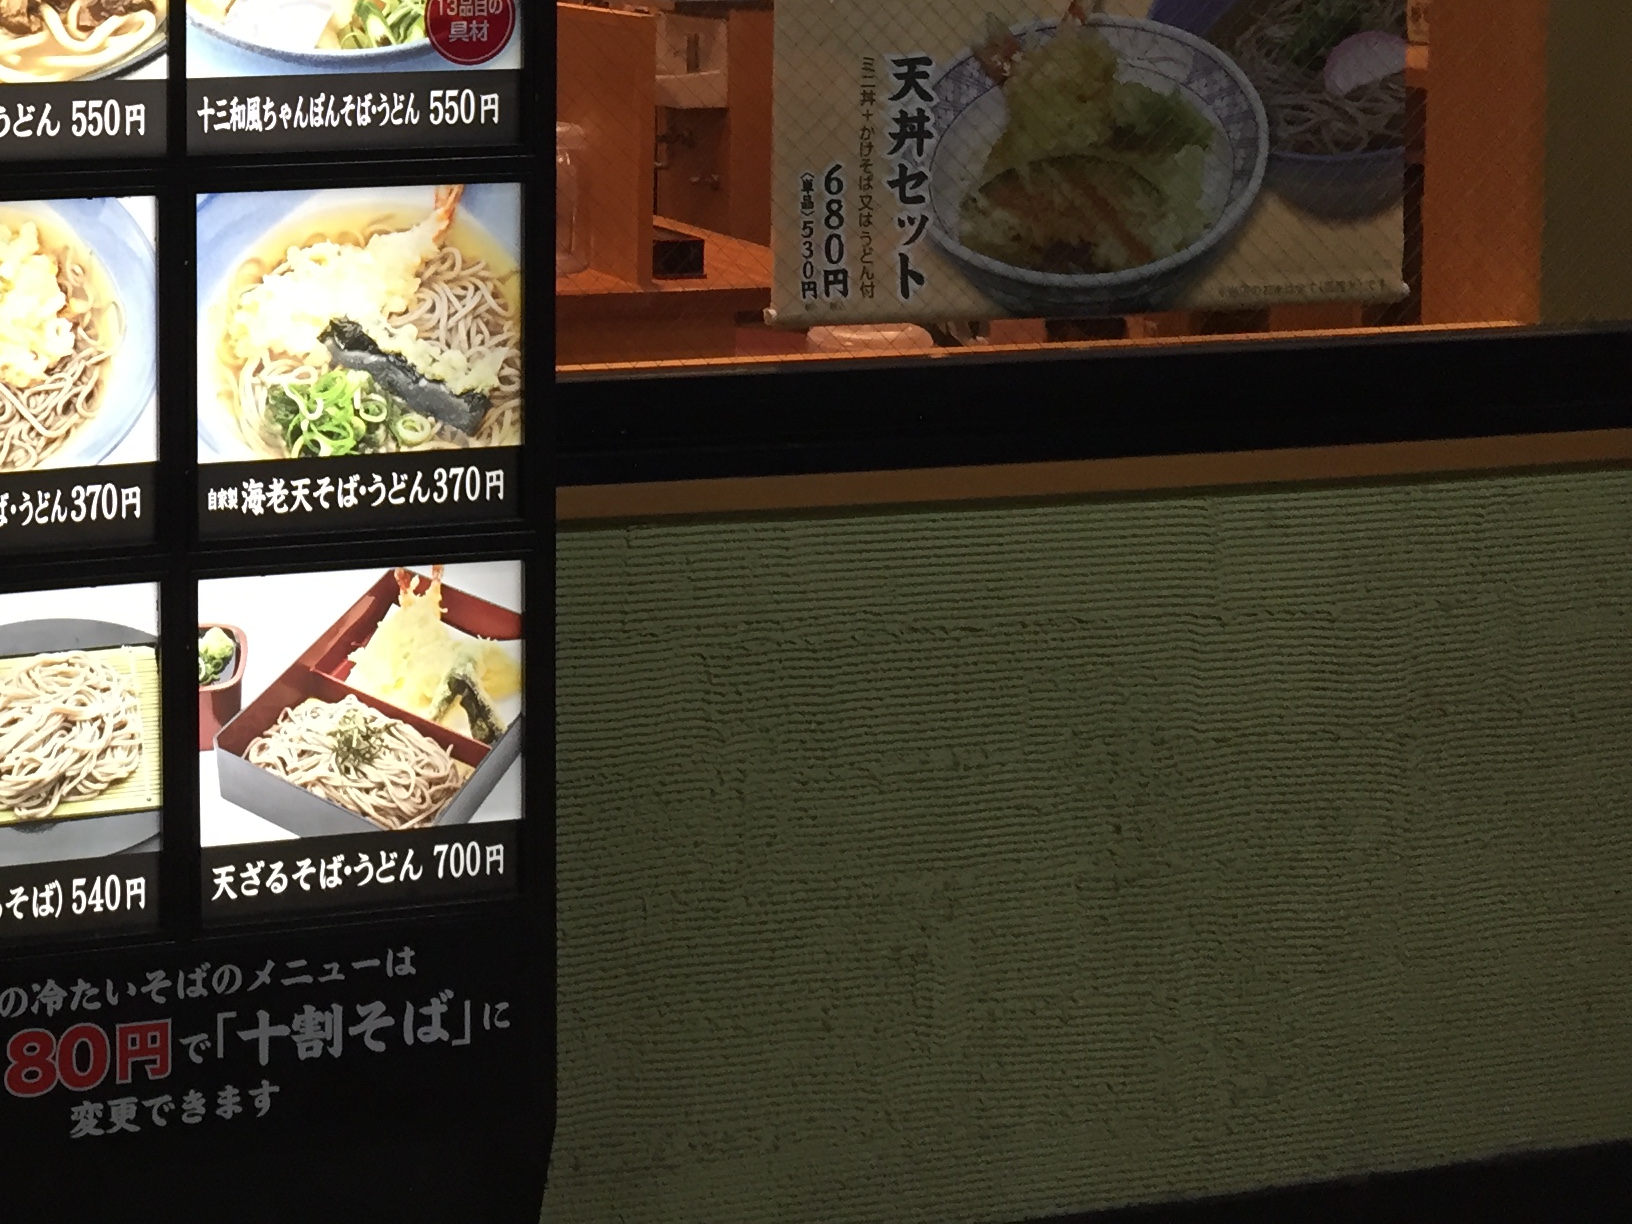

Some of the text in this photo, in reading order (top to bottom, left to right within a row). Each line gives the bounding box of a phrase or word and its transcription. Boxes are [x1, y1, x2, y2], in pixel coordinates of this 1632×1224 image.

[449, 20, 490, 43] 具材
[71, 98, 146, 138] 550円
[196, 88, 500, 134] 十三和風ちゃんぽんそば・うどん 550円
[886, 56, 935, 300] 天丼セット
[823, 163, 849, 299] 680円
[71, 874, 146, 915] 540円
[211, 840, 505, 902] 天ざるそば・うどん 700円
[69, 1080, 280, 1139] 変更できます
